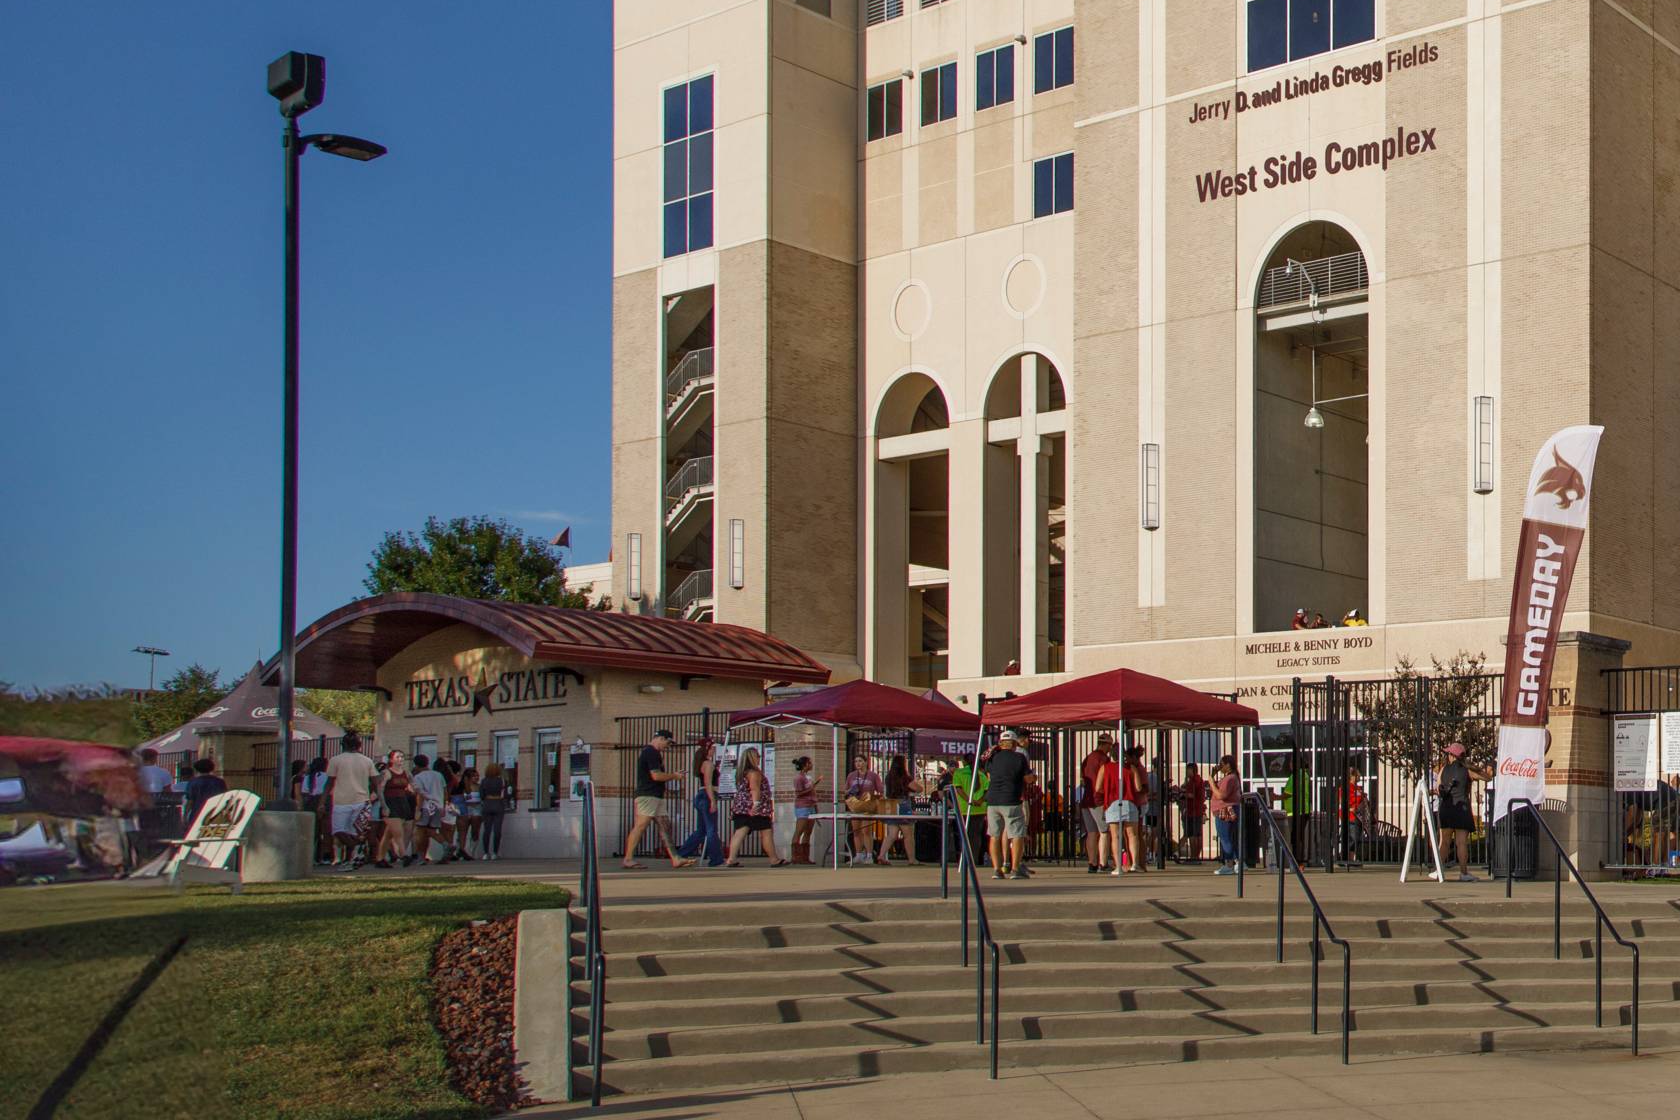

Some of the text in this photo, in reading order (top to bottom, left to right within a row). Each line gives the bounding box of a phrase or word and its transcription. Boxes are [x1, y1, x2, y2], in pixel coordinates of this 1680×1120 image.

[1189, 99, 1231, 124] Jerry
[1252, 83, 1282, 109] and
[1284, 71, 1330, 99] Linda
[1332, 60, 1383, 87] Gregg
[1386, 41, 1439, 73] Fields
[1196, 126, 1438, 203] West Side Complex
[1516, 533, 1566, 717] GAMEDAY
[1245, 637, 1373, 655] MICHELE & BENNY BOYD
[1276, 655, 1341, 668] LEGACY SUITES
[405, 667, 568, 711] TEXAS STATE
[1236, 687, 1258, 697] DAN
[1260, 687, 1267, 696] &
[941, 741, 979, 754] TEXA
